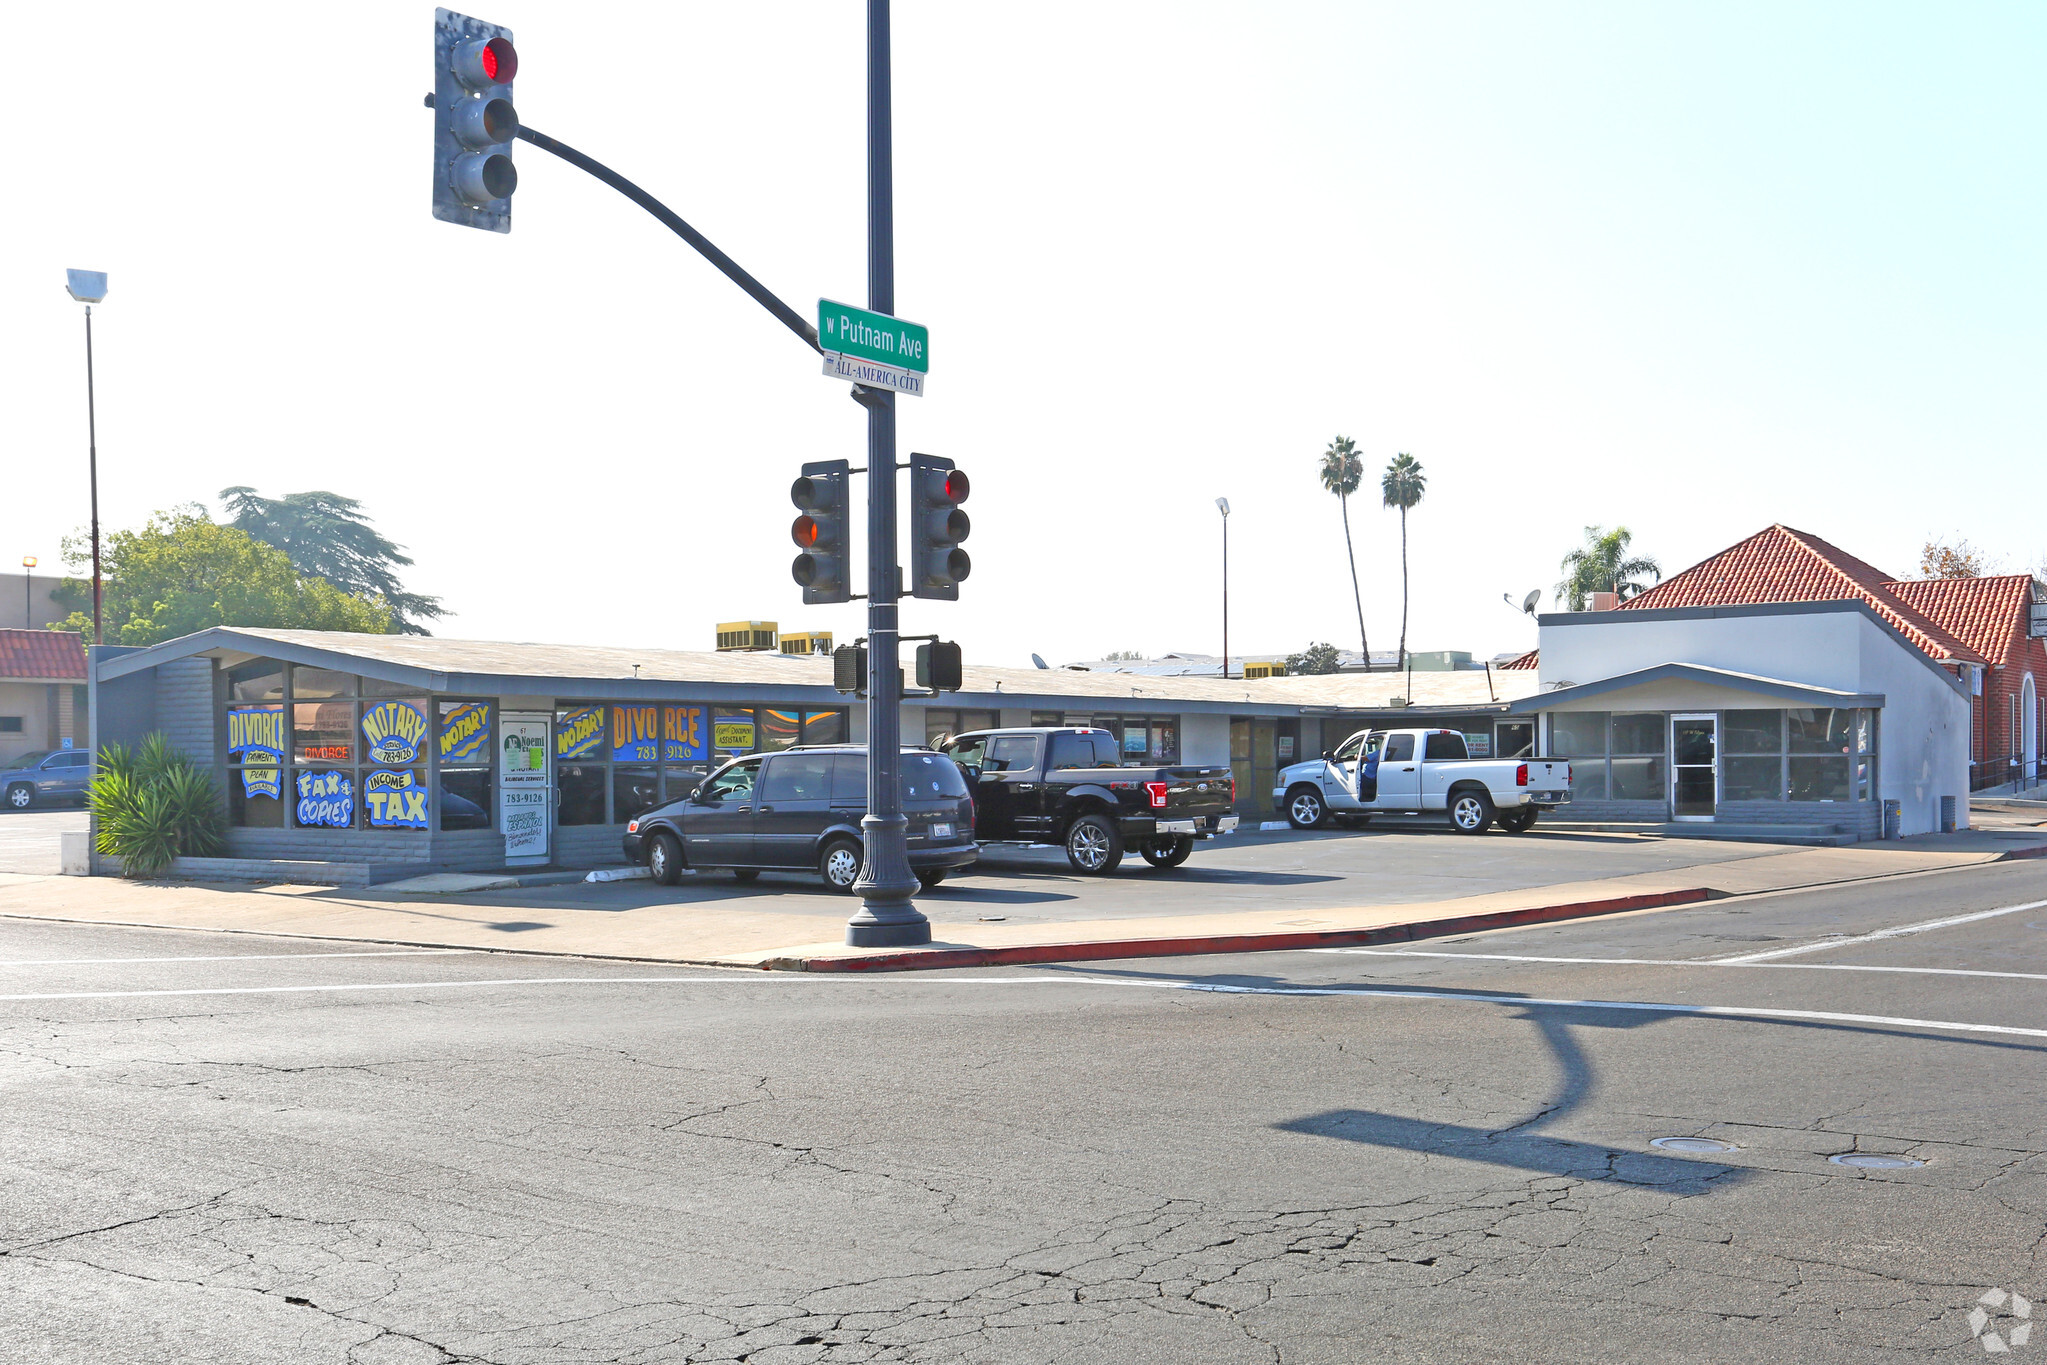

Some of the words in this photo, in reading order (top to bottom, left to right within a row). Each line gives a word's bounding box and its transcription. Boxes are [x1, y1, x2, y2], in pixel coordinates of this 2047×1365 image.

[826, 317, 834, 334] W
[840, 315, 893, 352] Putnam
[899, 331, 922, 359] Ave
[835, 361, 897, 387] ALL-AMERICA
[899, 375, 920, 392] CITY
[229, 712, 284, 752] DIVORCE
[362, 702, 427, 748] NOTARY
[440, 705, 489, 756] NOTARY
[557, 707, 604, 755] NOTARY
[304, 746, 349, 759] DIVORCE
[521, 736, 545, 747] Noemi
[246, 752, 274, 763] PAYMENT
[383, 747, 411, 763] 783-9126
[249, 770, 269, 779] PLAN
[299, 774, 340, 798] FAX
[341, 781, 351, 796] &
[370, 774, 405, 790] INCOME
[367, 791, 427, 822] TAX
[506, 793, 543, 803] 783-9126
[299, 798, 351, 823] COPIES
